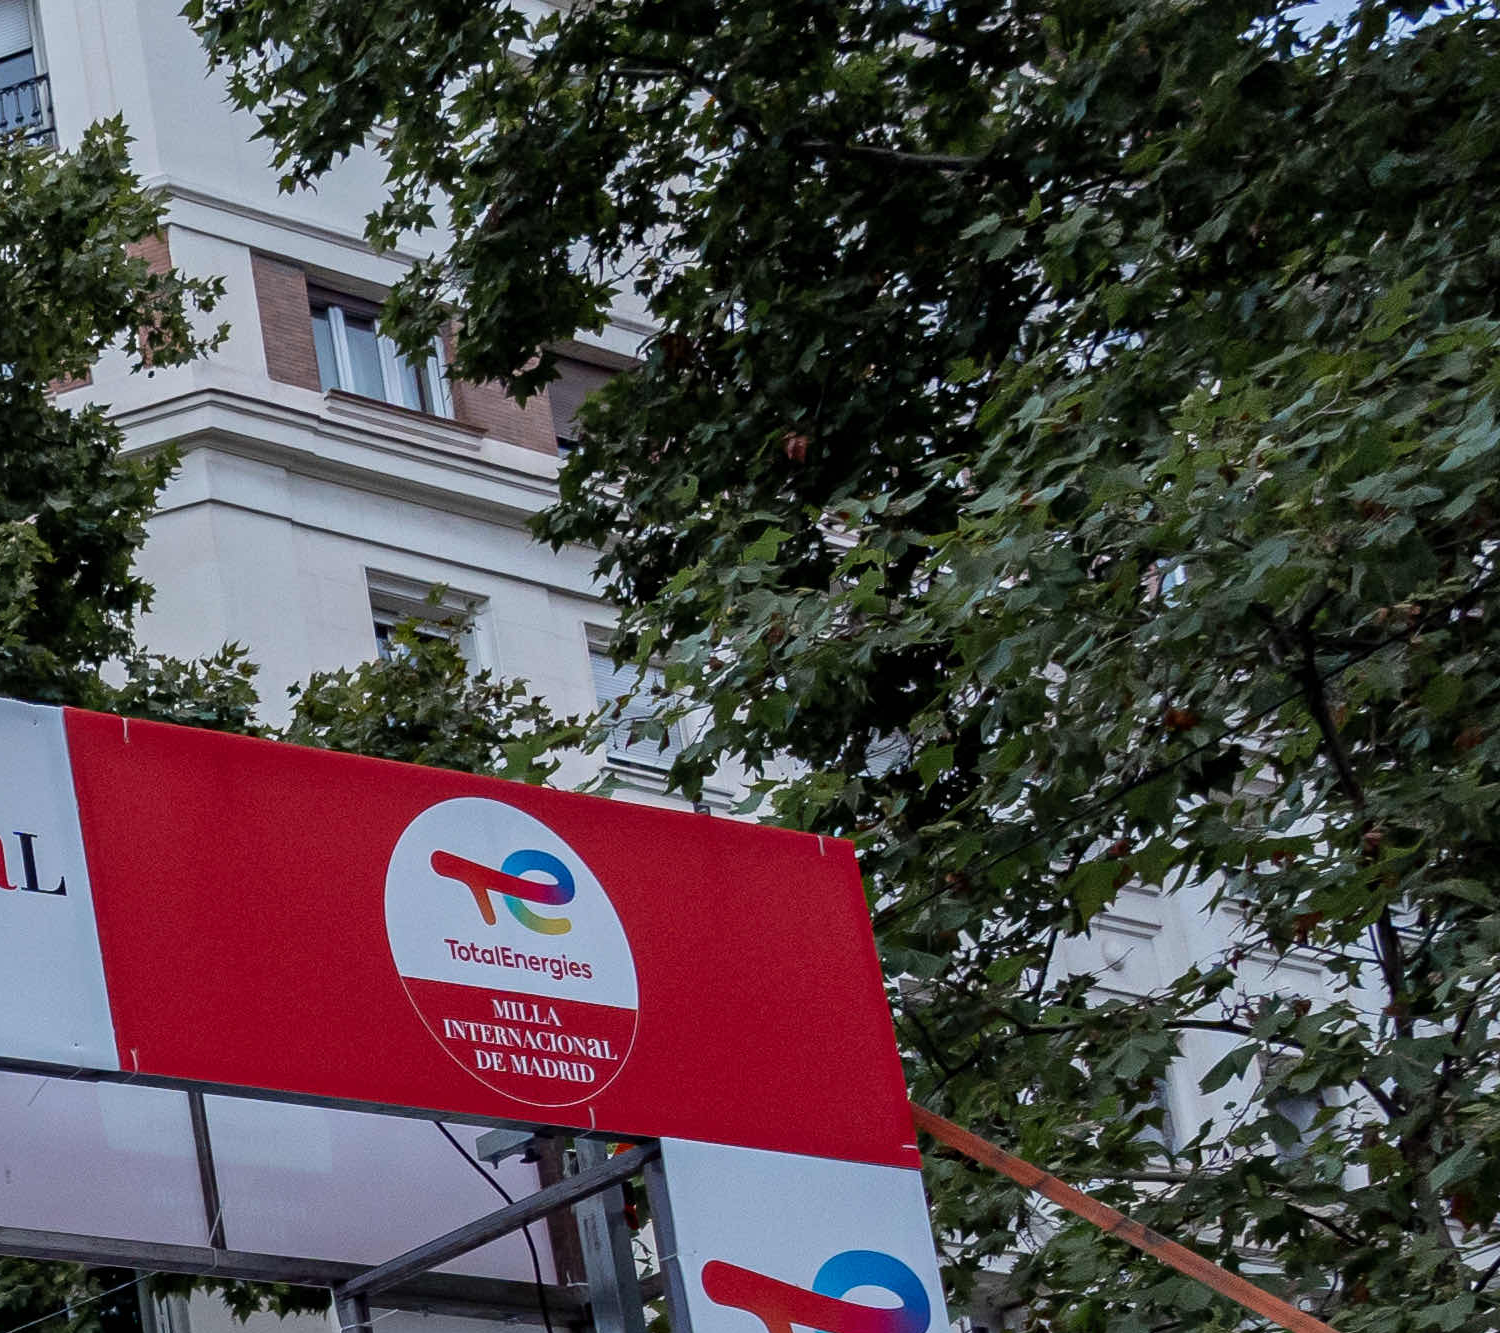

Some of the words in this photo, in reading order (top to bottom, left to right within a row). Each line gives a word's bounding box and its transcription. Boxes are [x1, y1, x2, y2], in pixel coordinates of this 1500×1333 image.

[443, 938, 593, 981] TotalEnergies
[492, 999, 563, 1027] MILLA
[474, 1049, 507, 1072] DE
[510, 1054, 596, 1084] MADRID
